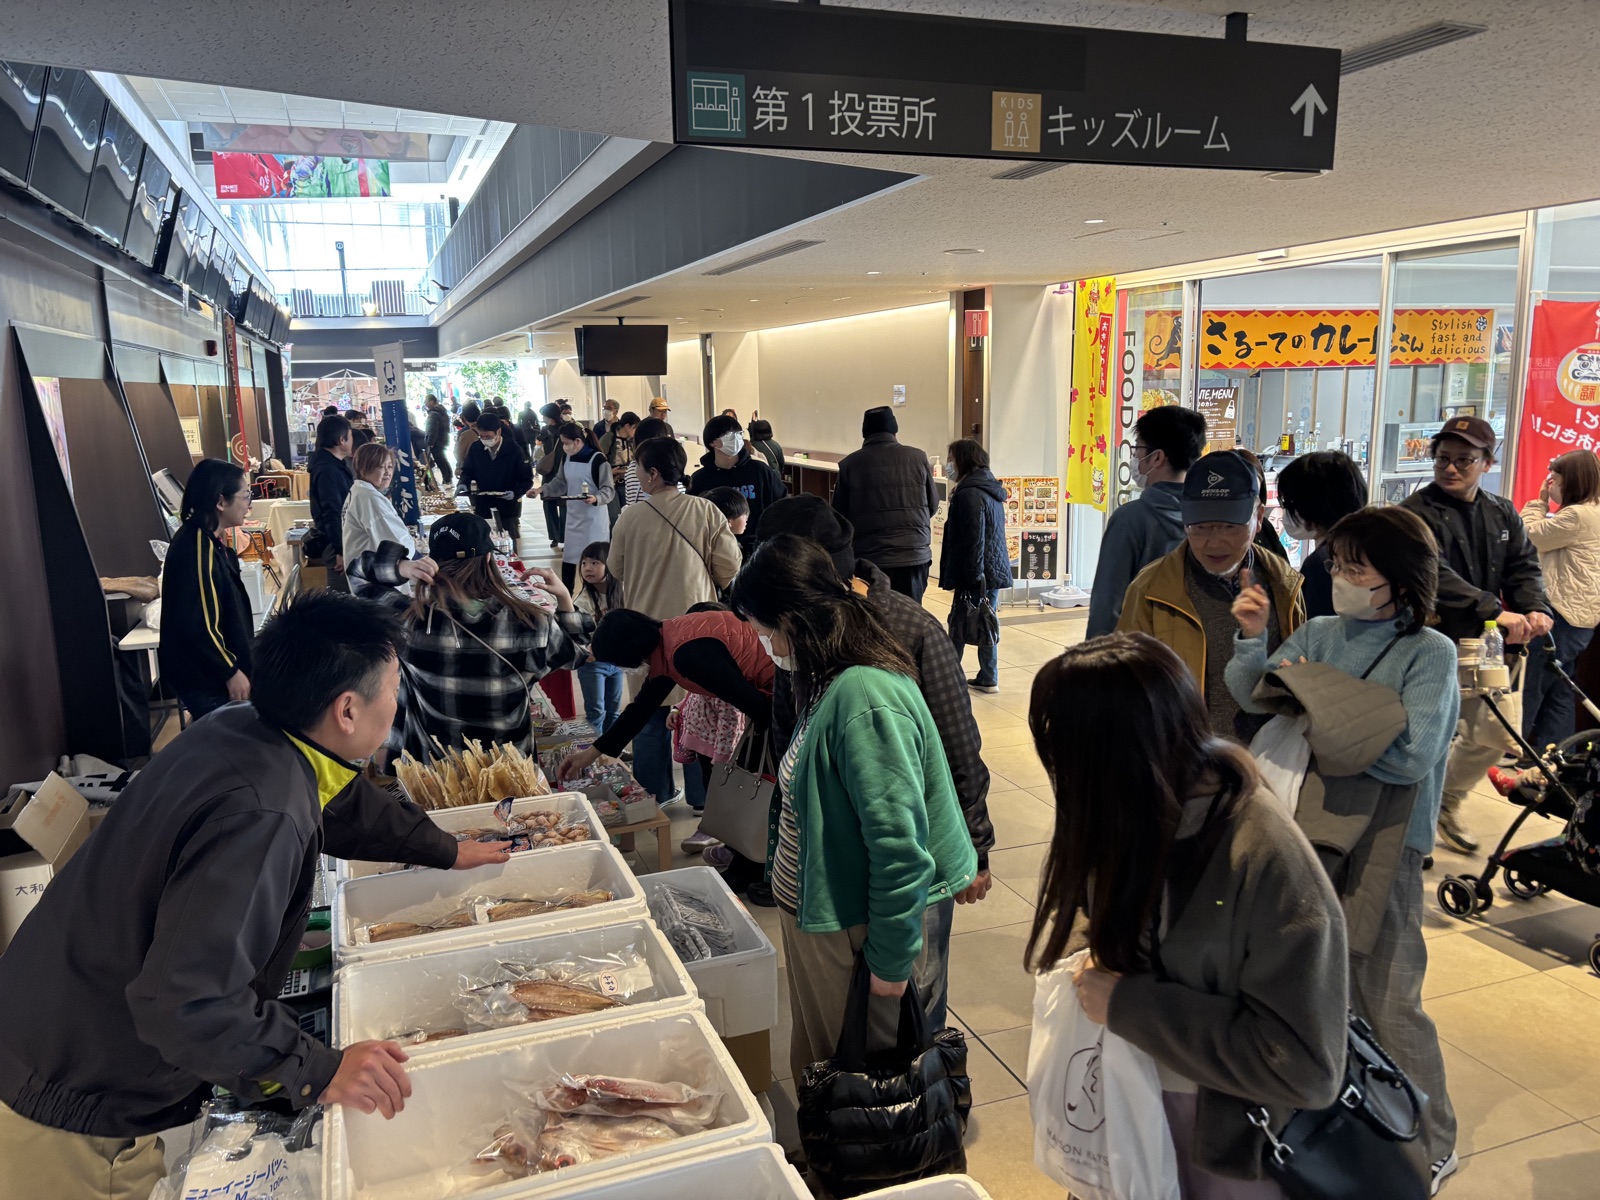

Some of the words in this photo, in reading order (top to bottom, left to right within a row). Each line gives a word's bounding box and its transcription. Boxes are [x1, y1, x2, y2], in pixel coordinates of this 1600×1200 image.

[751, 85, 937, 141] 第1投票所
[1000, 97, 1034, 110] KIDS
[1047, 105, 1231, 152] キッズルーム
[1431, 318, 1473, 331] Stylish
[1431, 332, 1456, 343] fast
[1462, 333, 1482, 342] and
[1430, 343, 1486, 355] delicious
[1119, 330, 1136, 428] FOOD
[1117, 439, 1132, 506] COU
